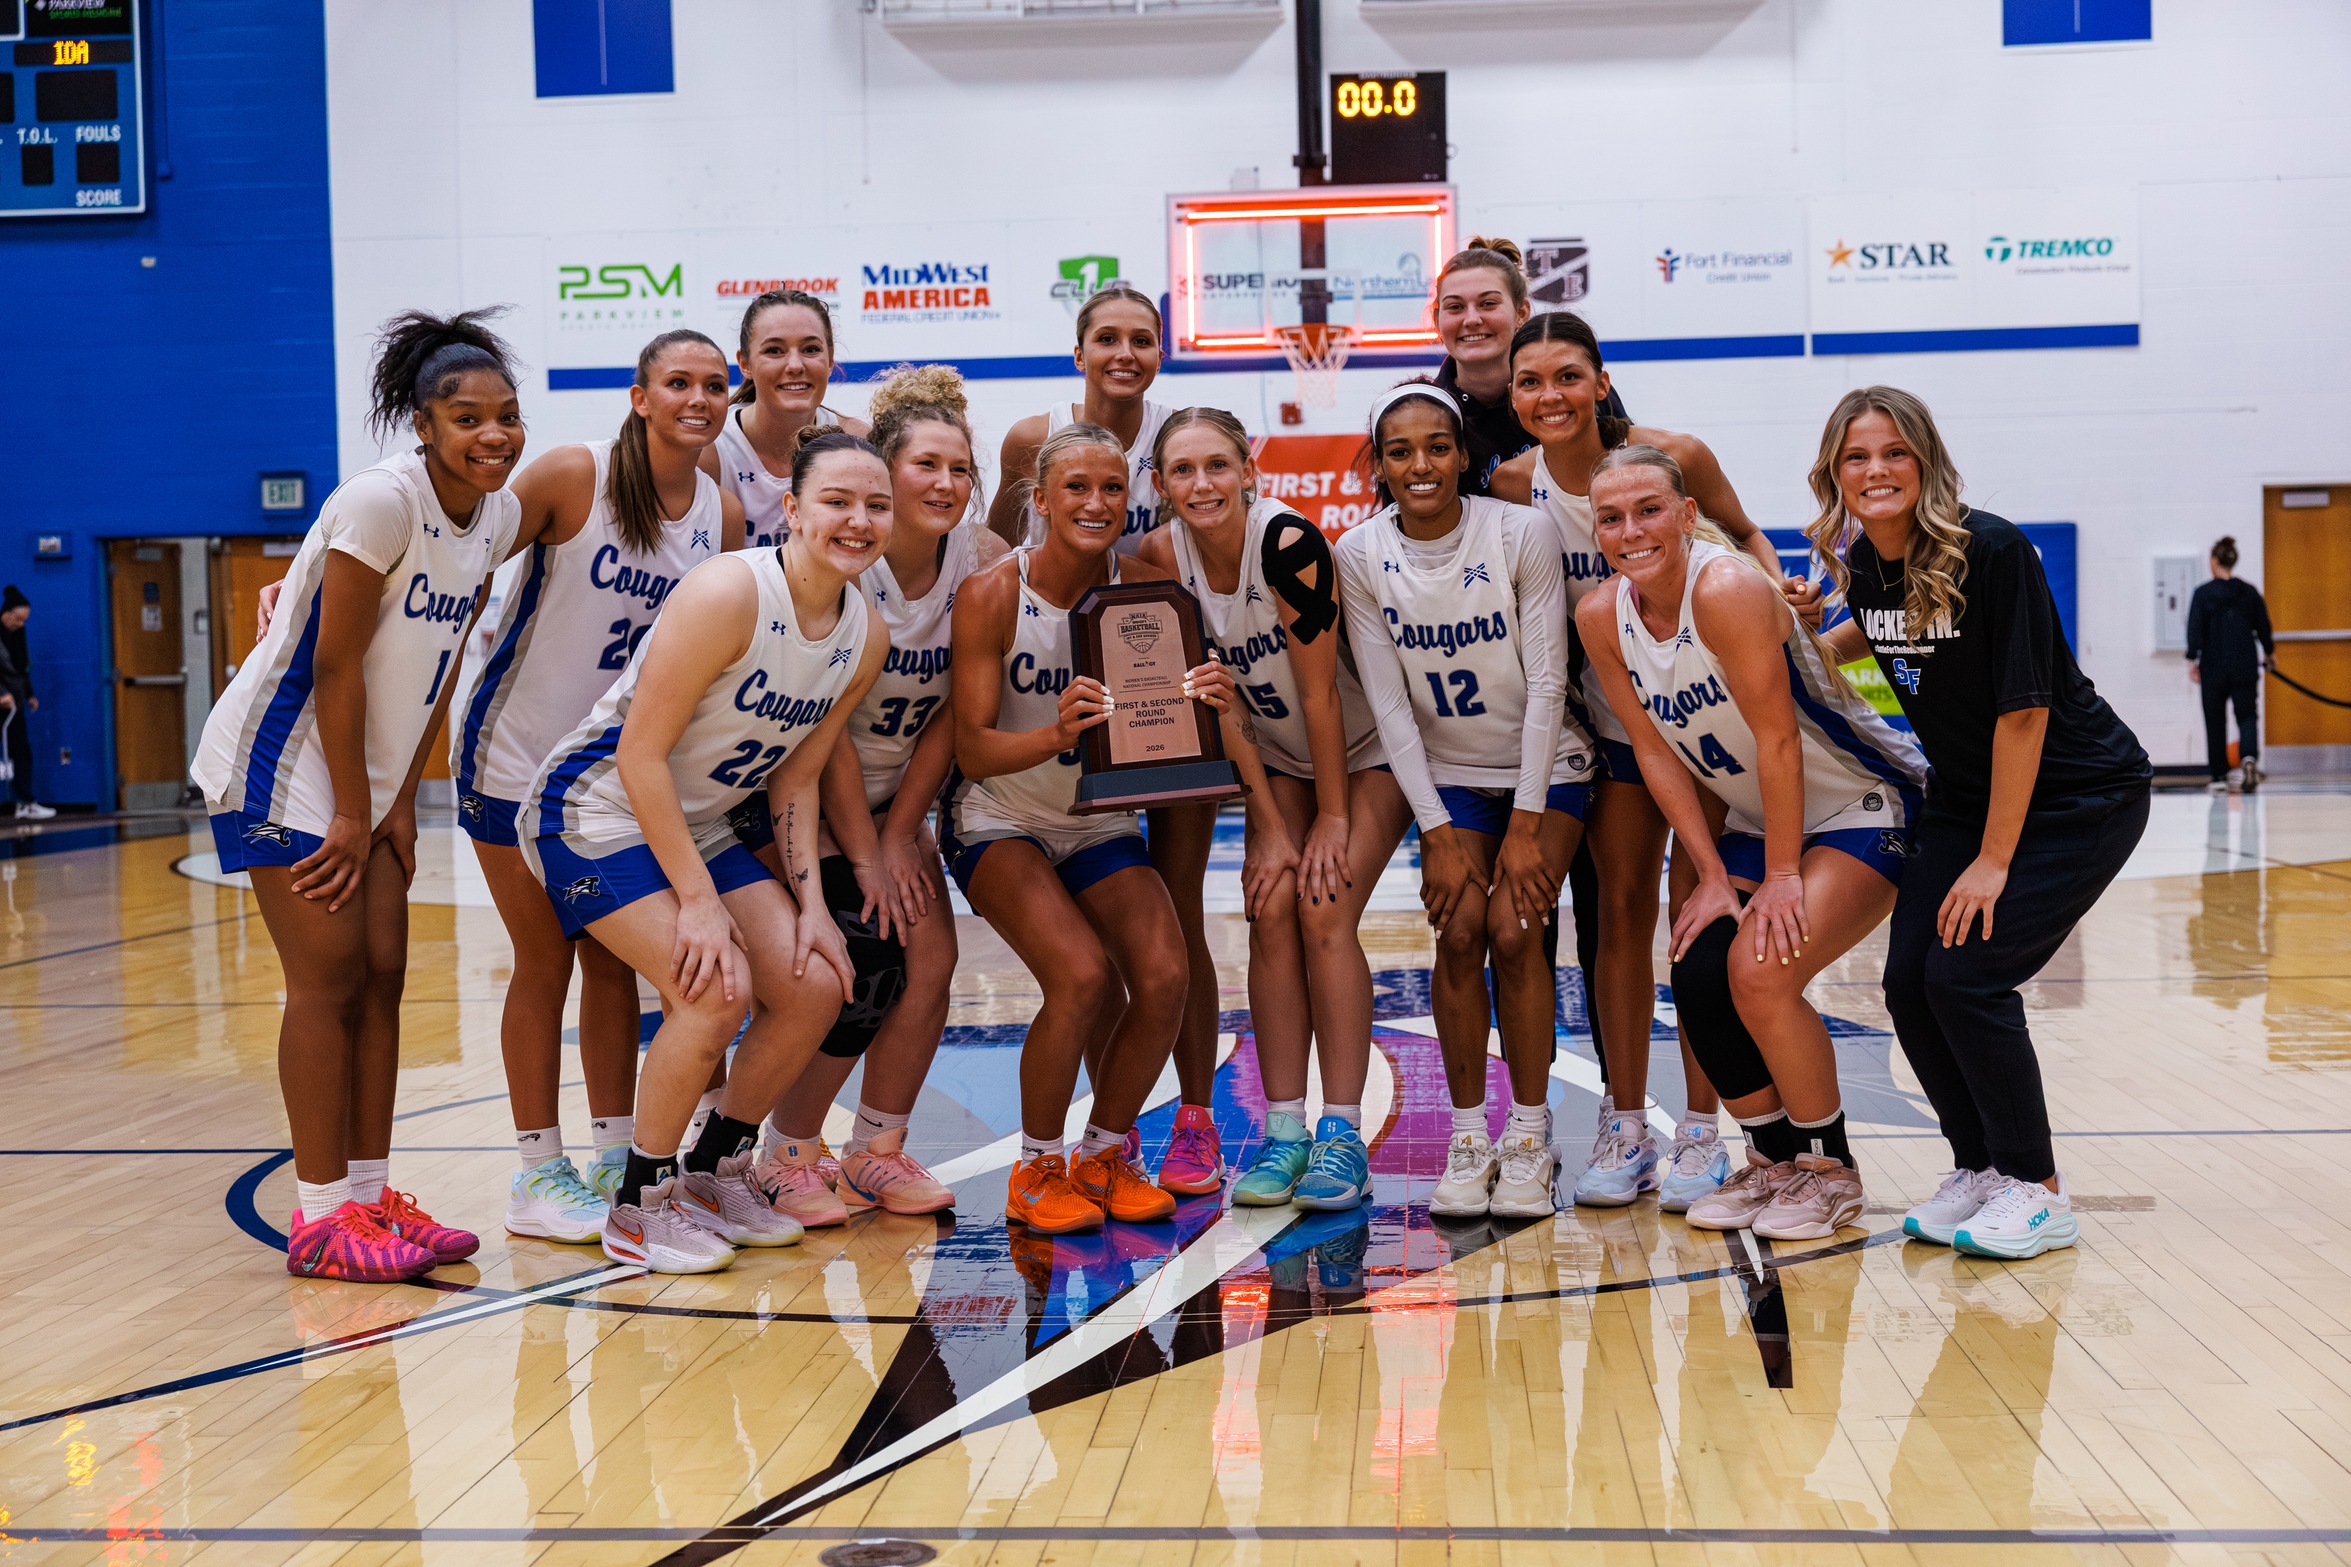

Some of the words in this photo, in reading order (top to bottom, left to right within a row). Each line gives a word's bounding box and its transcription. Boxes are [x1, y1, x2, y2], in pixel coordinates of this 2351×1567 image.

[1338, 80, 1416, 117] 00.0
[76, 125, 121, 143] FOULS
[76, 189, 122, 207] SCORE
[1685, 252, 1717, 269] Fort
[1722, 250, 1792, 268] Financial
[1860, 241, 1951, 270] STAR
[2018, 238, 2113, 259] TREMCO
[560, 263, 682, 299] PSM
[863, 287, 991, 311] AMERICA
[1120, 623, 1160, 634] BASKETBALL
[1382, 607, 1507, 658] Cougars
[1893, 658, 1921, 695] SF
[1115, 701, 1139, 710] FIRST
[1150, 697, 1184, 707] SECOND
[1425, 669, 1487, 717] 12
[870, 695, 941, 737] 33
[1129, 717, 1175, 728] CHAMPION
[1136, 708, 1166, 718] ROUND
[1146, 744, 1165, 752] 2026
[707, 740, 787, 789] 22
[2027, 1207, 2051, 1231] HOKA
